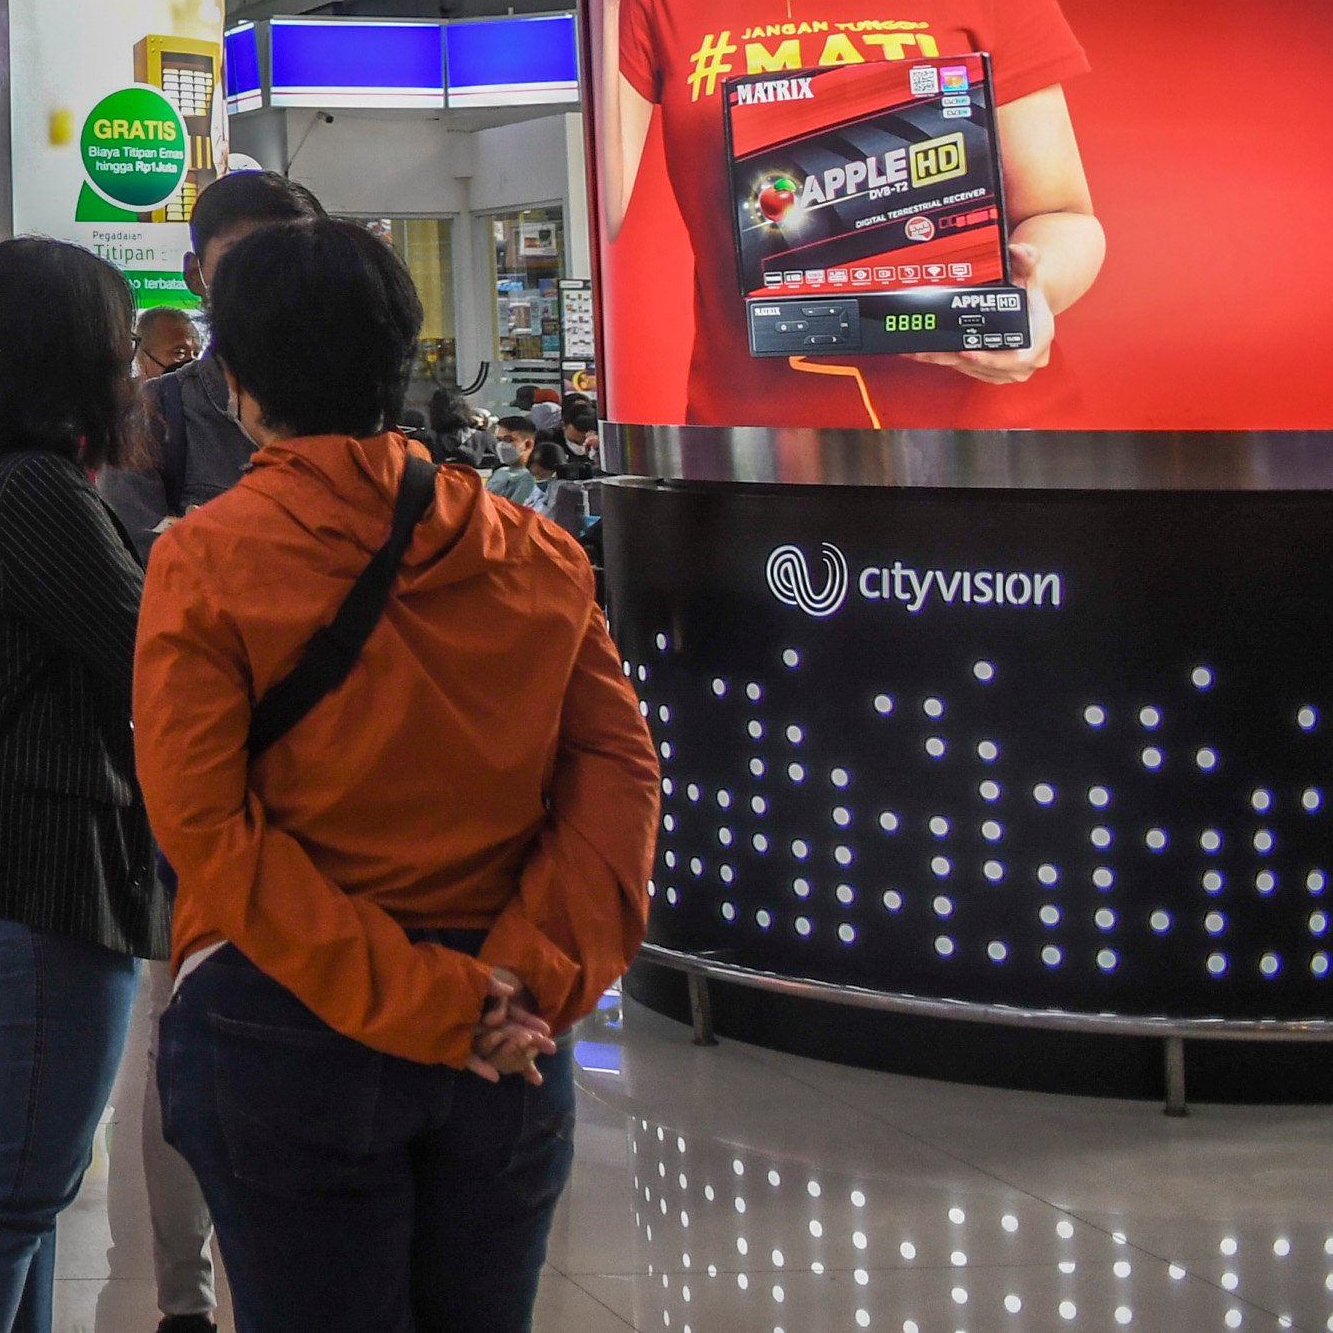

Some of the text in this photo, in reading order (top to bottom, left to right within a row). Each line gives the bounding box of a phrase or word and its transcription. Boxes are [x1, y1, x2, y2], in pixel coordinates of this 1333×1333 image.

[741, 21, 828, 39] JANGAN
[736, 77, 814, 105] MATRIX
[94, 119, 177, 141] GRATIS
[88, 146, 120, 159] Biaya
[123, 146, 157, 159] Titipan
[96, 161, 133, 174] hingga
[800, 148, 959, 209] APPLE HD
[869, 181, 909, 201] DVB-T2
[855, 214, 886, 229] DIGITAL
[887, 201, 942, 222] TERRESTRIAL
[942, 187, 986, 207] RECEIVER
[93, 231, 142, 240] Pegadaian
[951, 295, 1017, 308] APPLE HD
[856, 561, 1062, 612] cityvision
